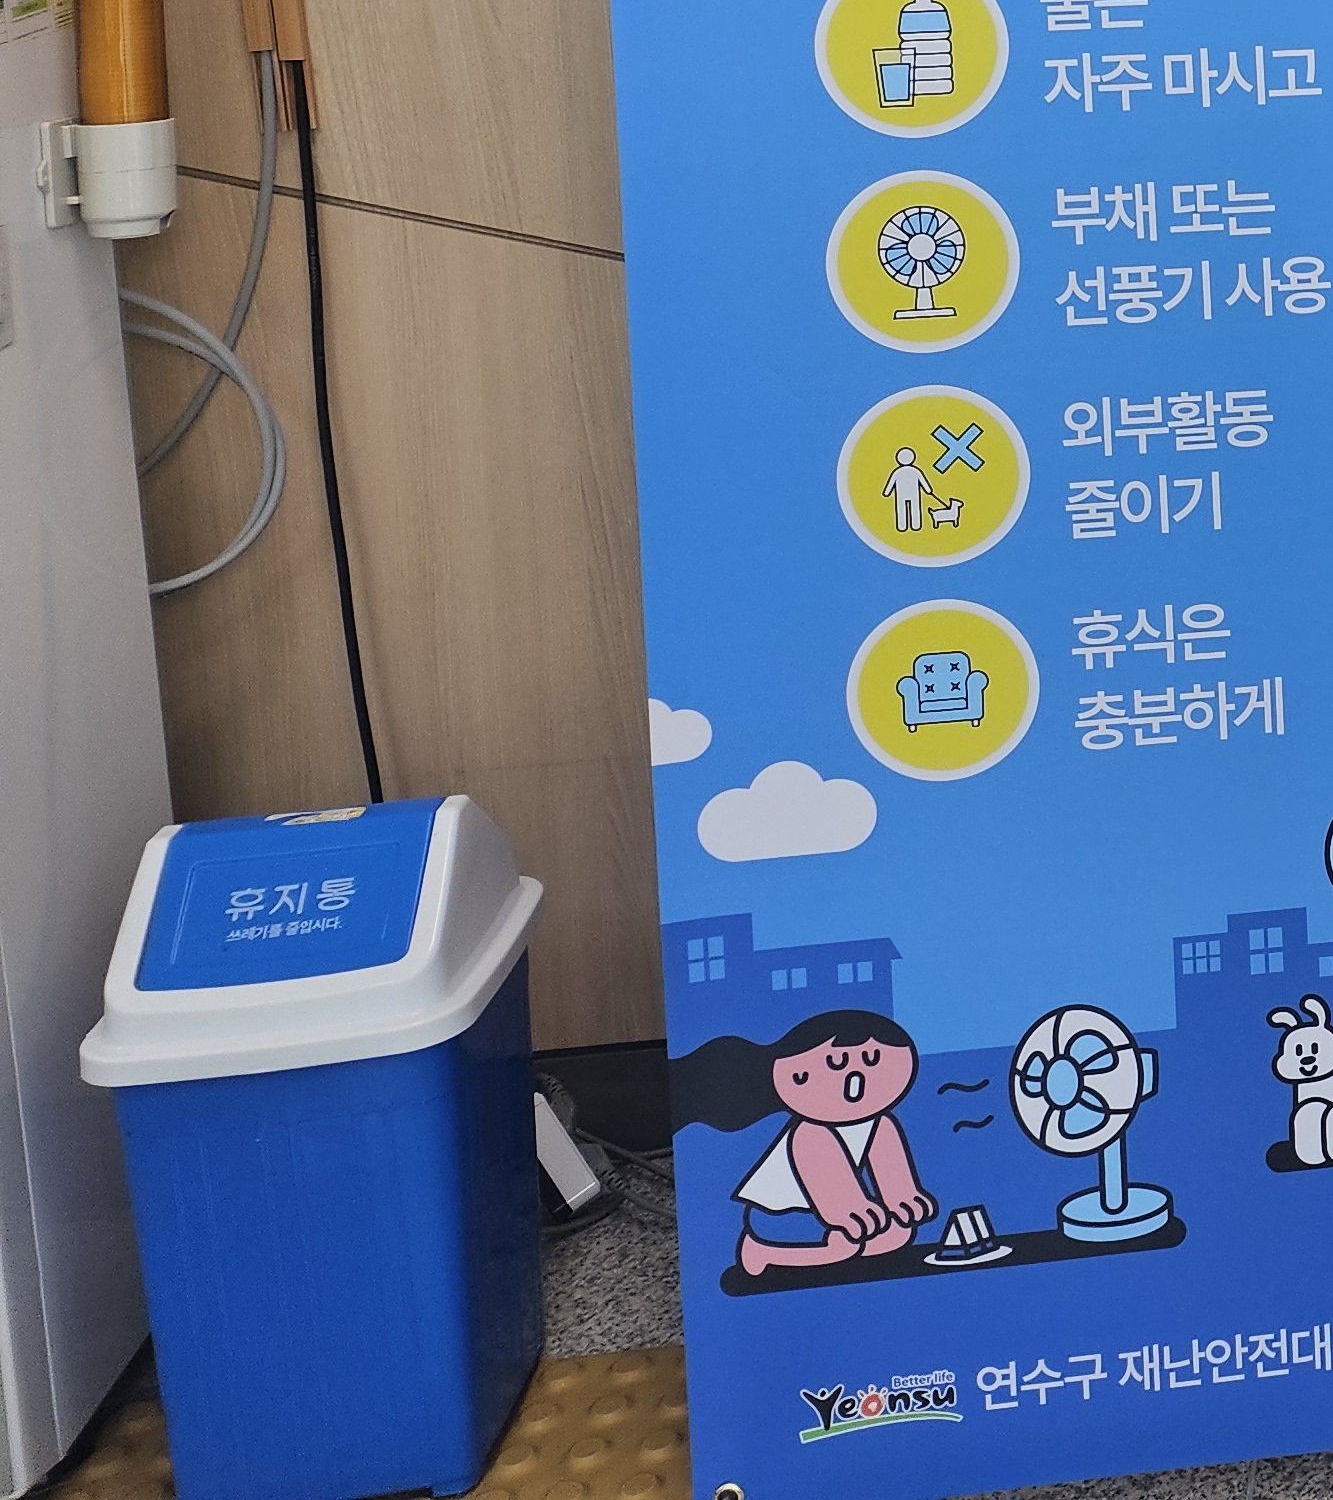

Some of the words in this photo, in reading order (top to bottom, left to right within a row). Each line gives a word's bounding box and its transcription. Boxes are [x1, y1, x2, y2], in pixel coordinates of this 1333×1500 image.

[1044, 53, 1153, 112] 자주
[1163, 46, 1322, 107] 마시고
[1051, 182, 1158, 245] 부채
[1169, 180, 1275, 236] 또는
[1055, 260, 1211, 326] 선풍기
[1226, 256, 1331, 317] 사용
[1062, 390, 1274, 456] 외부활동
[1064, 471, 1222, 540] 줄이기
[1071, 603, 1231, 670] 휴식은
[1074, 677, 1286, 750] 충분하게
[225, 877, 355, 921] 휴지통
[801, 1383, 957, 1432] Yeonsu
[892, 1373, 930, 1388] Better
[932, 1370, 955, 1385] life
[976, 1355, 1107, 1411] 연수구
